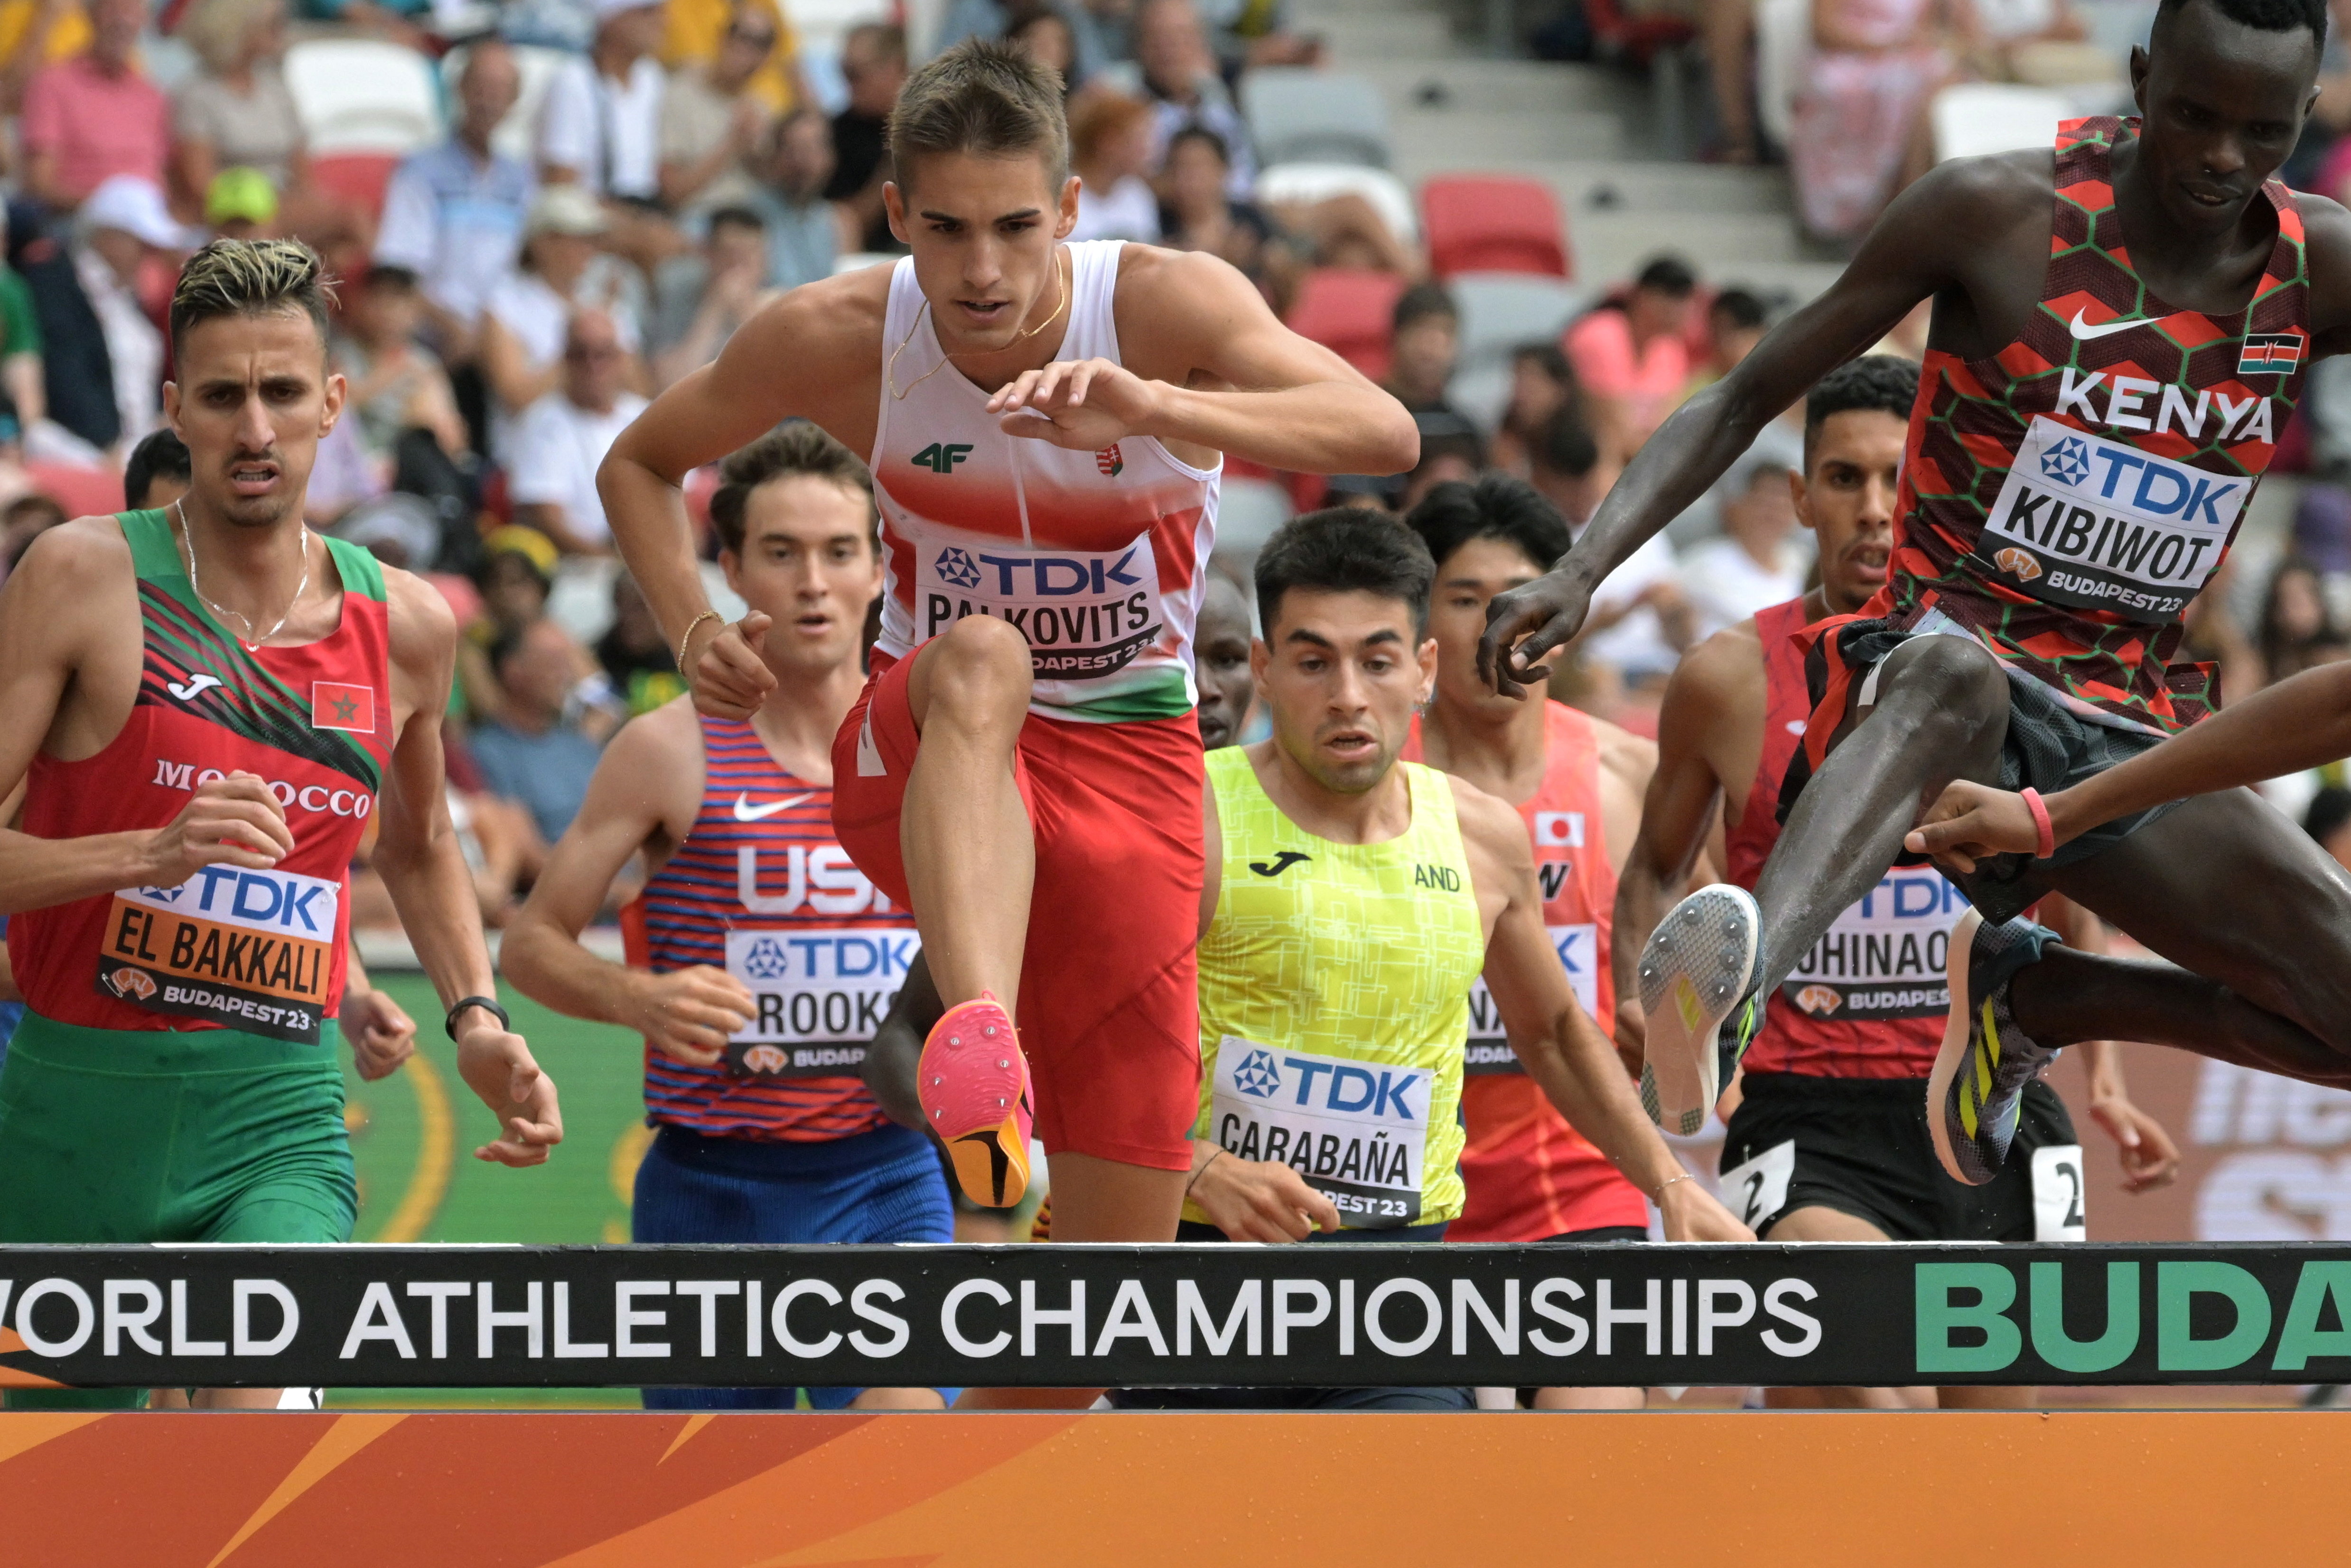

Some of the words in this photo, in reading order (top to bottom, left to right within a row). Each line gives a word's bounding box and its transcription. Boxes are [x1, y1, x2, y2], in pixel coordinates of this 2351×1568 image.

[2054, 367, 2273, 445] KENYA
[911, 443, 973, 473] 4F
[2095, 445, 2239, 524] TDK
[2004, 486, 2213, 580] KIBIWOT
[979, 547, 1142, 595] TDK
[928, 591, 1150, 645] PKOVITS
[152, 759, 370, 819] MOOCCO
[197, 866, 324, 932] TDK
[737, 845, 891, 914] US
[1415, 864, 1460, 892] AND
[115, 907, 157, 962] EL
[169, 922, 320, 995] BAKKALI
[788, 938, 910, 978] TDK
[757, 991, 900, 1035] ROOK
[1284, 1056, 1419, 1120] TDK
[1221, 1113, 1409, 1186] CARABAÑA
[1743, 1171, 1766, 1223] 2
[2056, 1162, 2083, 1227] 2
[339, 1278, 910, 1359] ATHLETICS
[940, 1278, 1822, 1357] CHAMPIONSHIPS
[1915, 1261, 2351, 1373] BUDA
